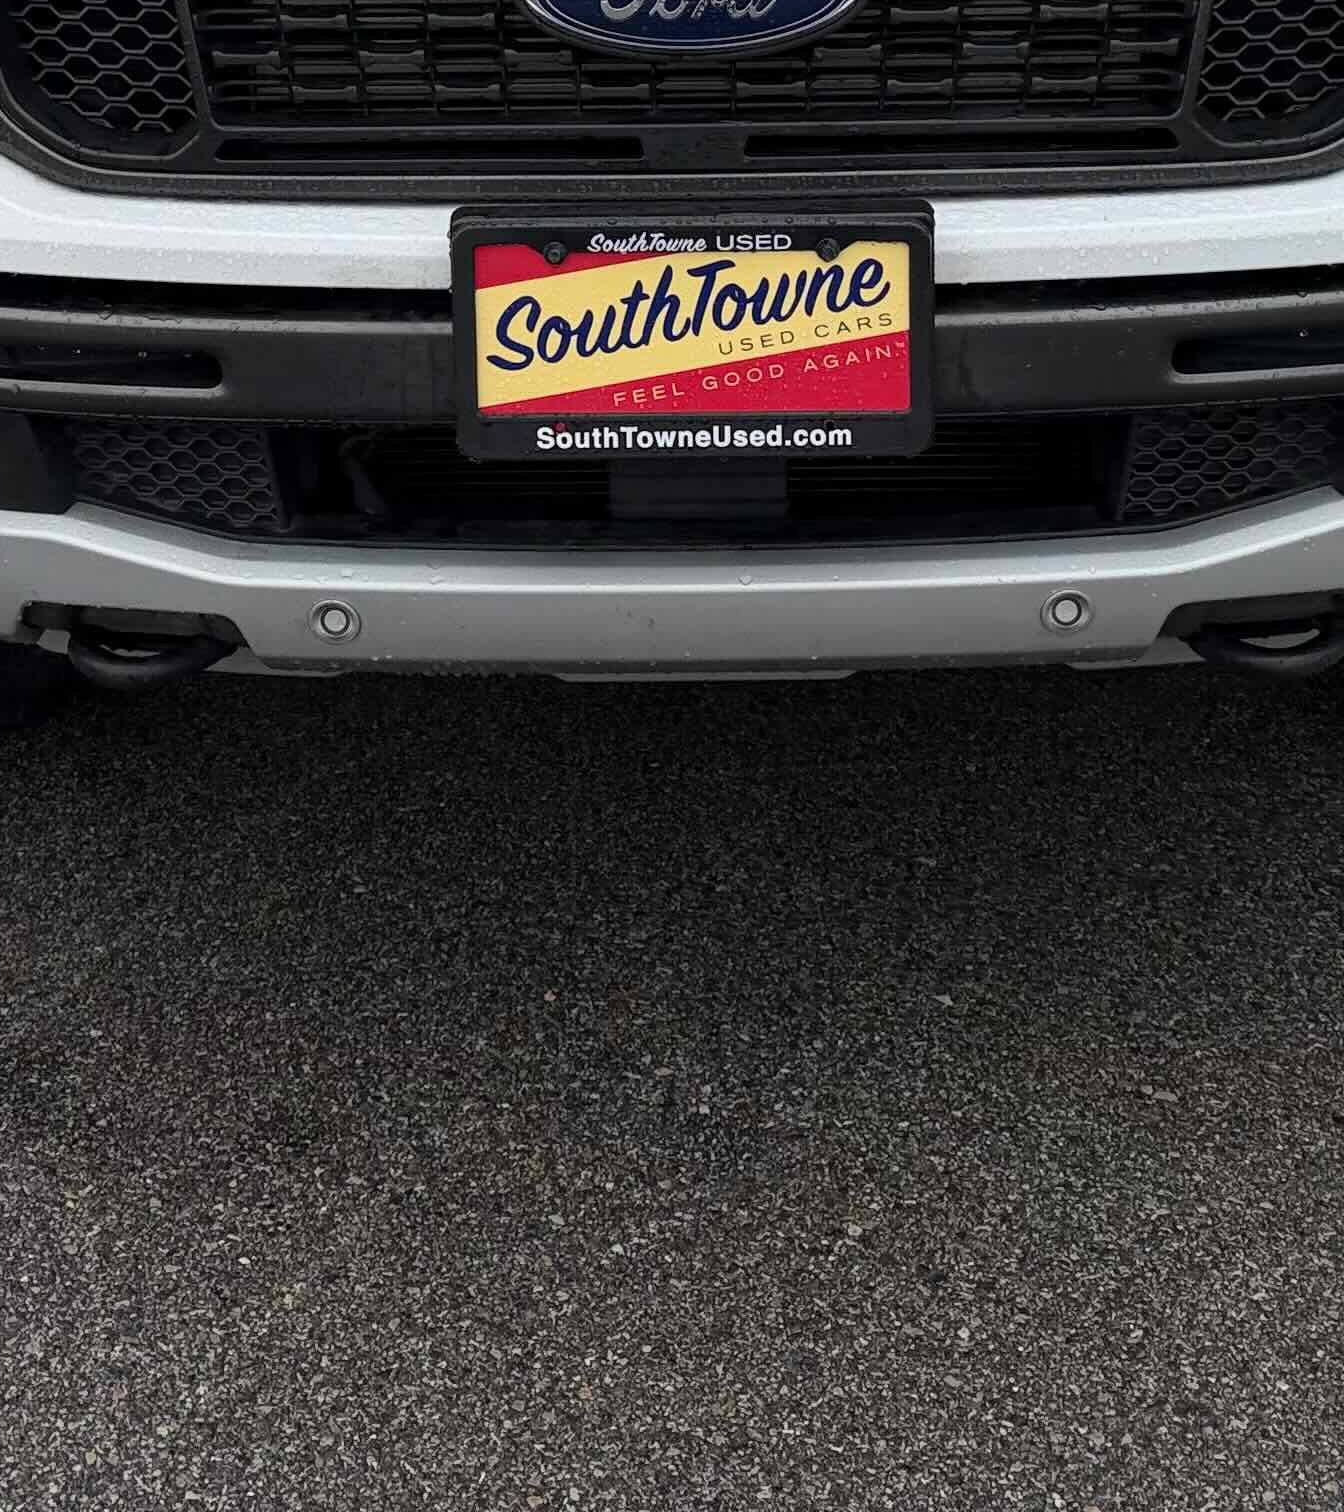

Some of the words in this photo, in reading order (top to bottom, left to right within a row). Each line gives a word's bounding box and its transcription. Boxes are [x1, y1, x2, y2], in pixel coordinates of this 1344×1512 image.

[587, 231, 706, 254] SouthTowne
[716, 234, 792, 251] USED
[486, 258, 891, 371] SouthTowne
[719, 330, 795, 356] USED
[814, 312, 893, 338] CARS
[613, 383, 685, 407] FEEL
[702, 364, 785, 392] GOOD
[536, 425, 852, 451] SouthTowneUsed.com
